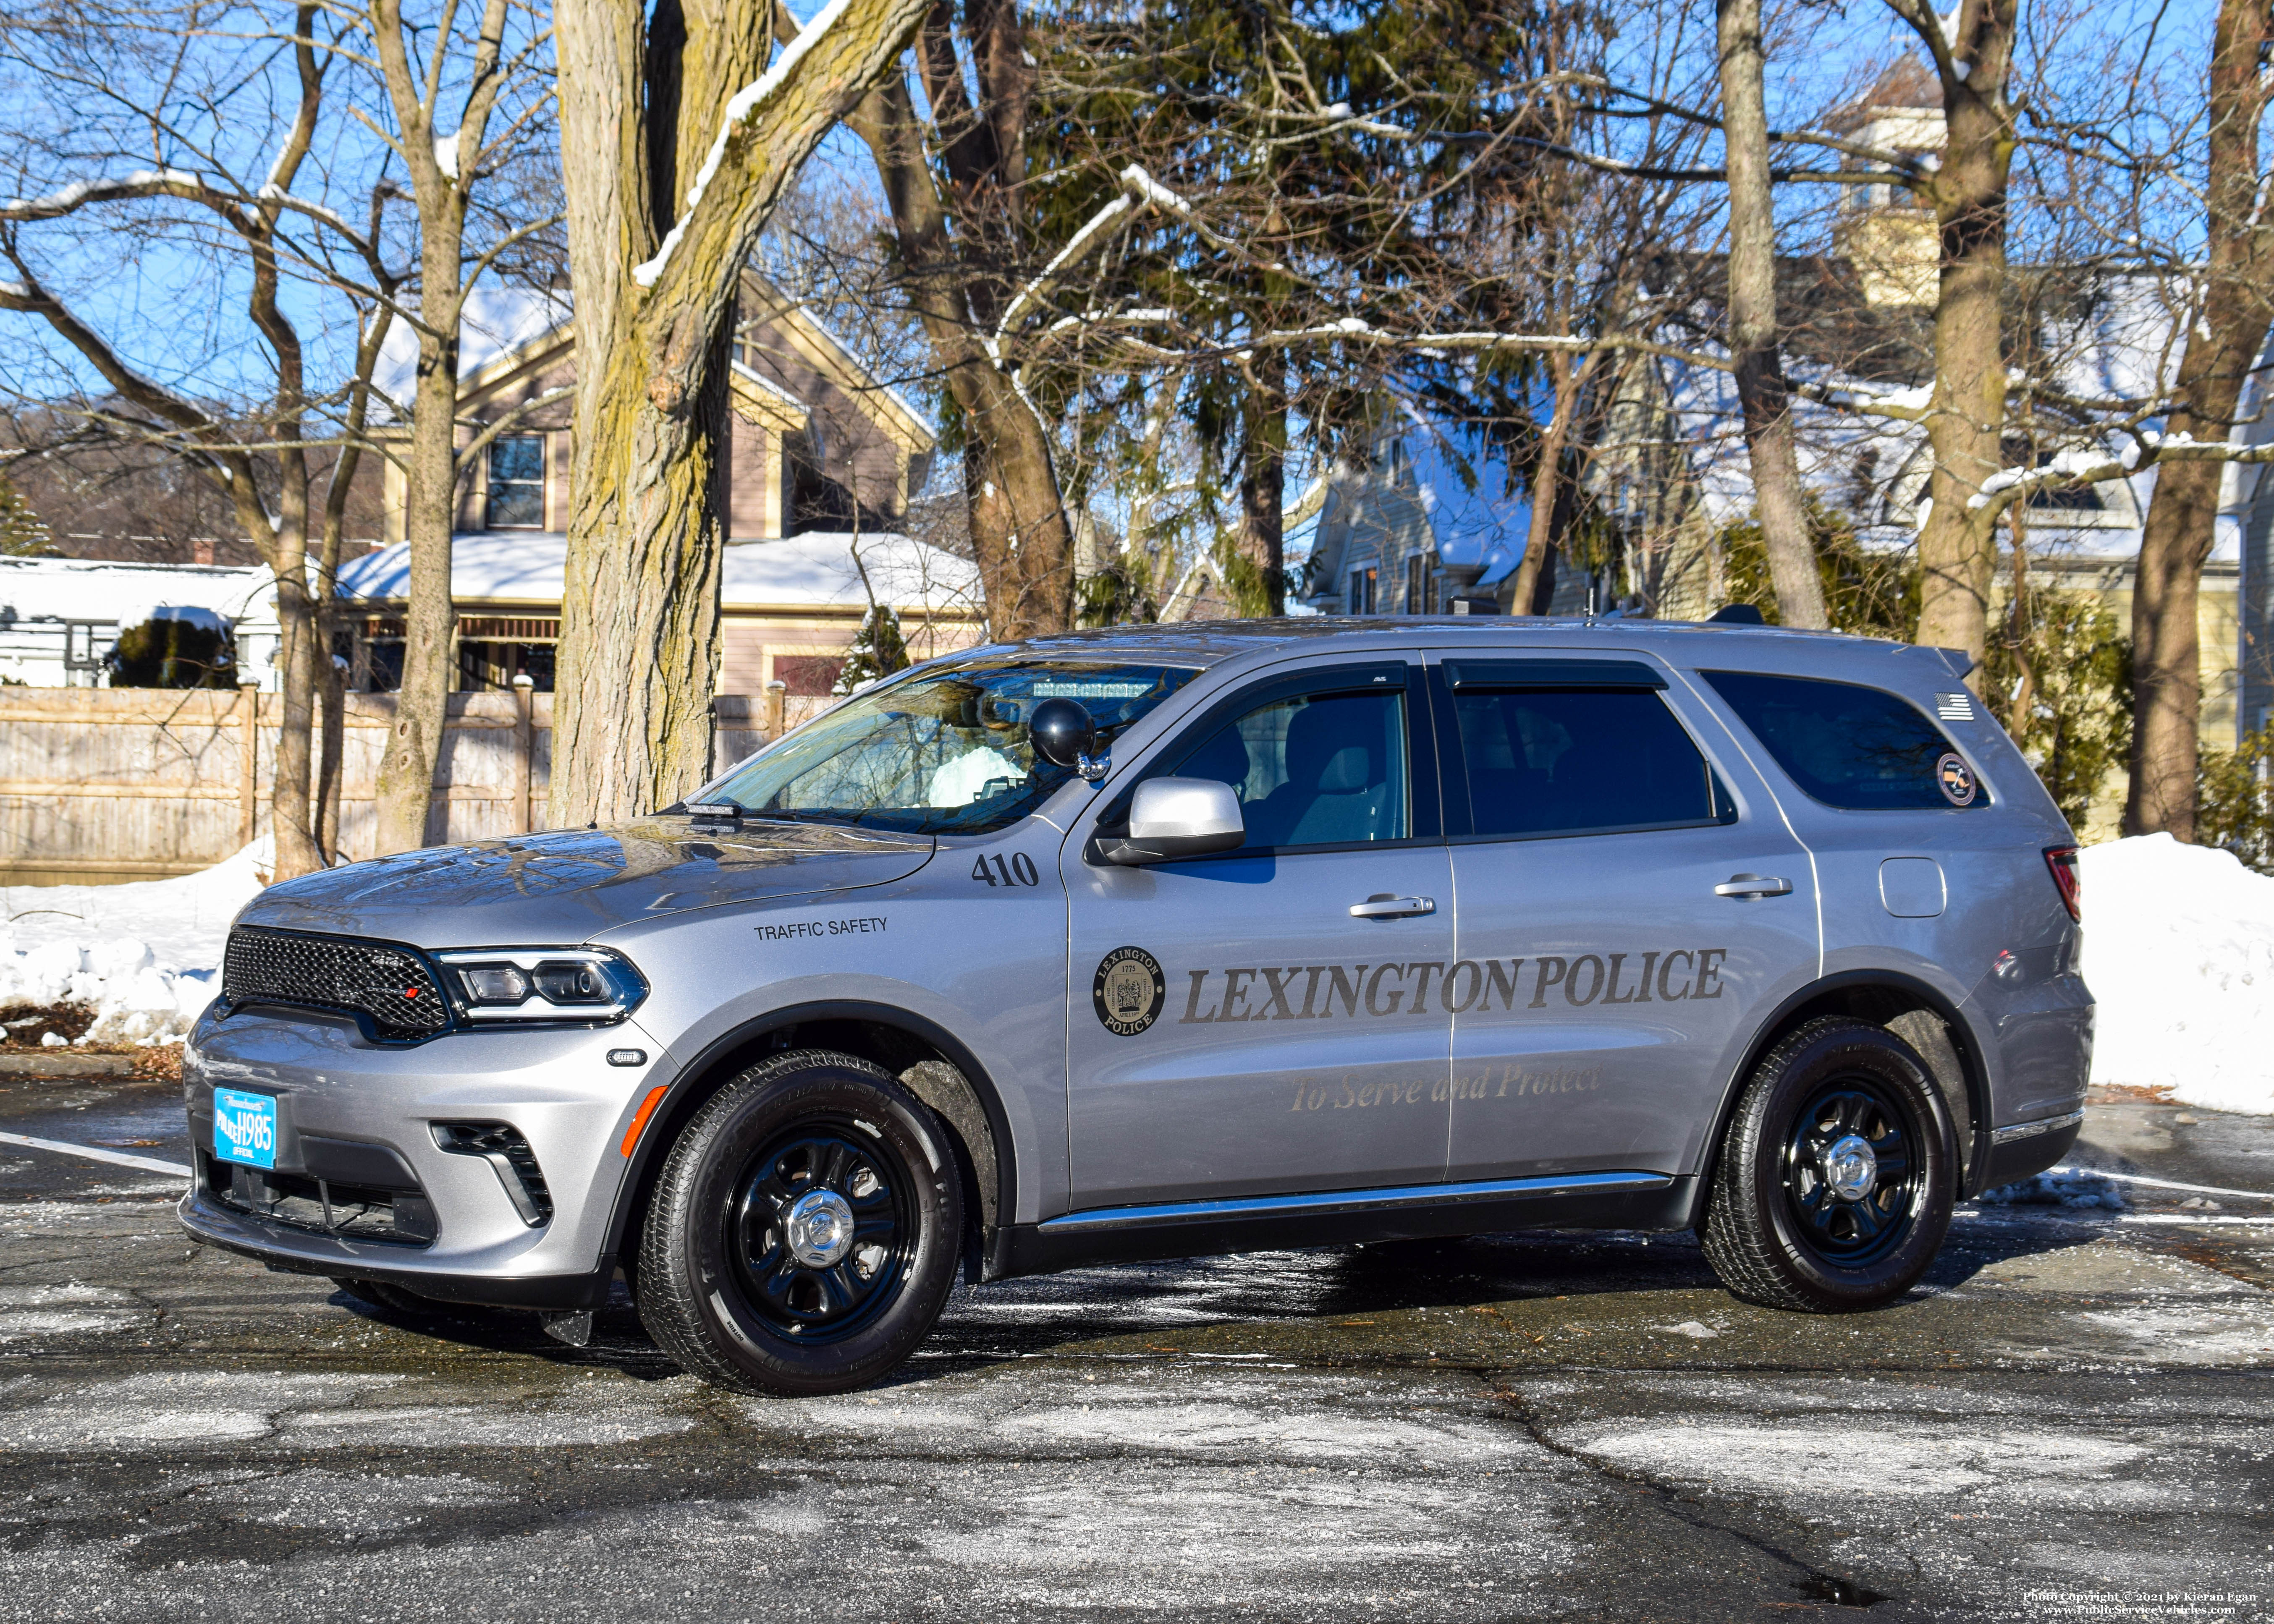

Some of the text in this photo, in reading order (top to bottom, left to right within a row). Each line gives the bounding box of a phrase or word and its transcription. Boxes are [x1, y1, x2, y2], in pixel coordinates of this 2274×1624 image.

[972, 852, 1039, 887] 410
[754, 917, 888, 941] TRAFFIC SAFETY
[1098, 949, 1159, 979] LEXINGTON
[1179, 948, 1726, 1024] LEXINGTON POLICE
[1104, 1013, 1153, 1034] POLICE
[1289, 1063, 1604, 1111] To Serve and Protect
[217, 1109, 272, 1151] POLICE H985
[726, 1320, 744, 1341] OUTSIDE
